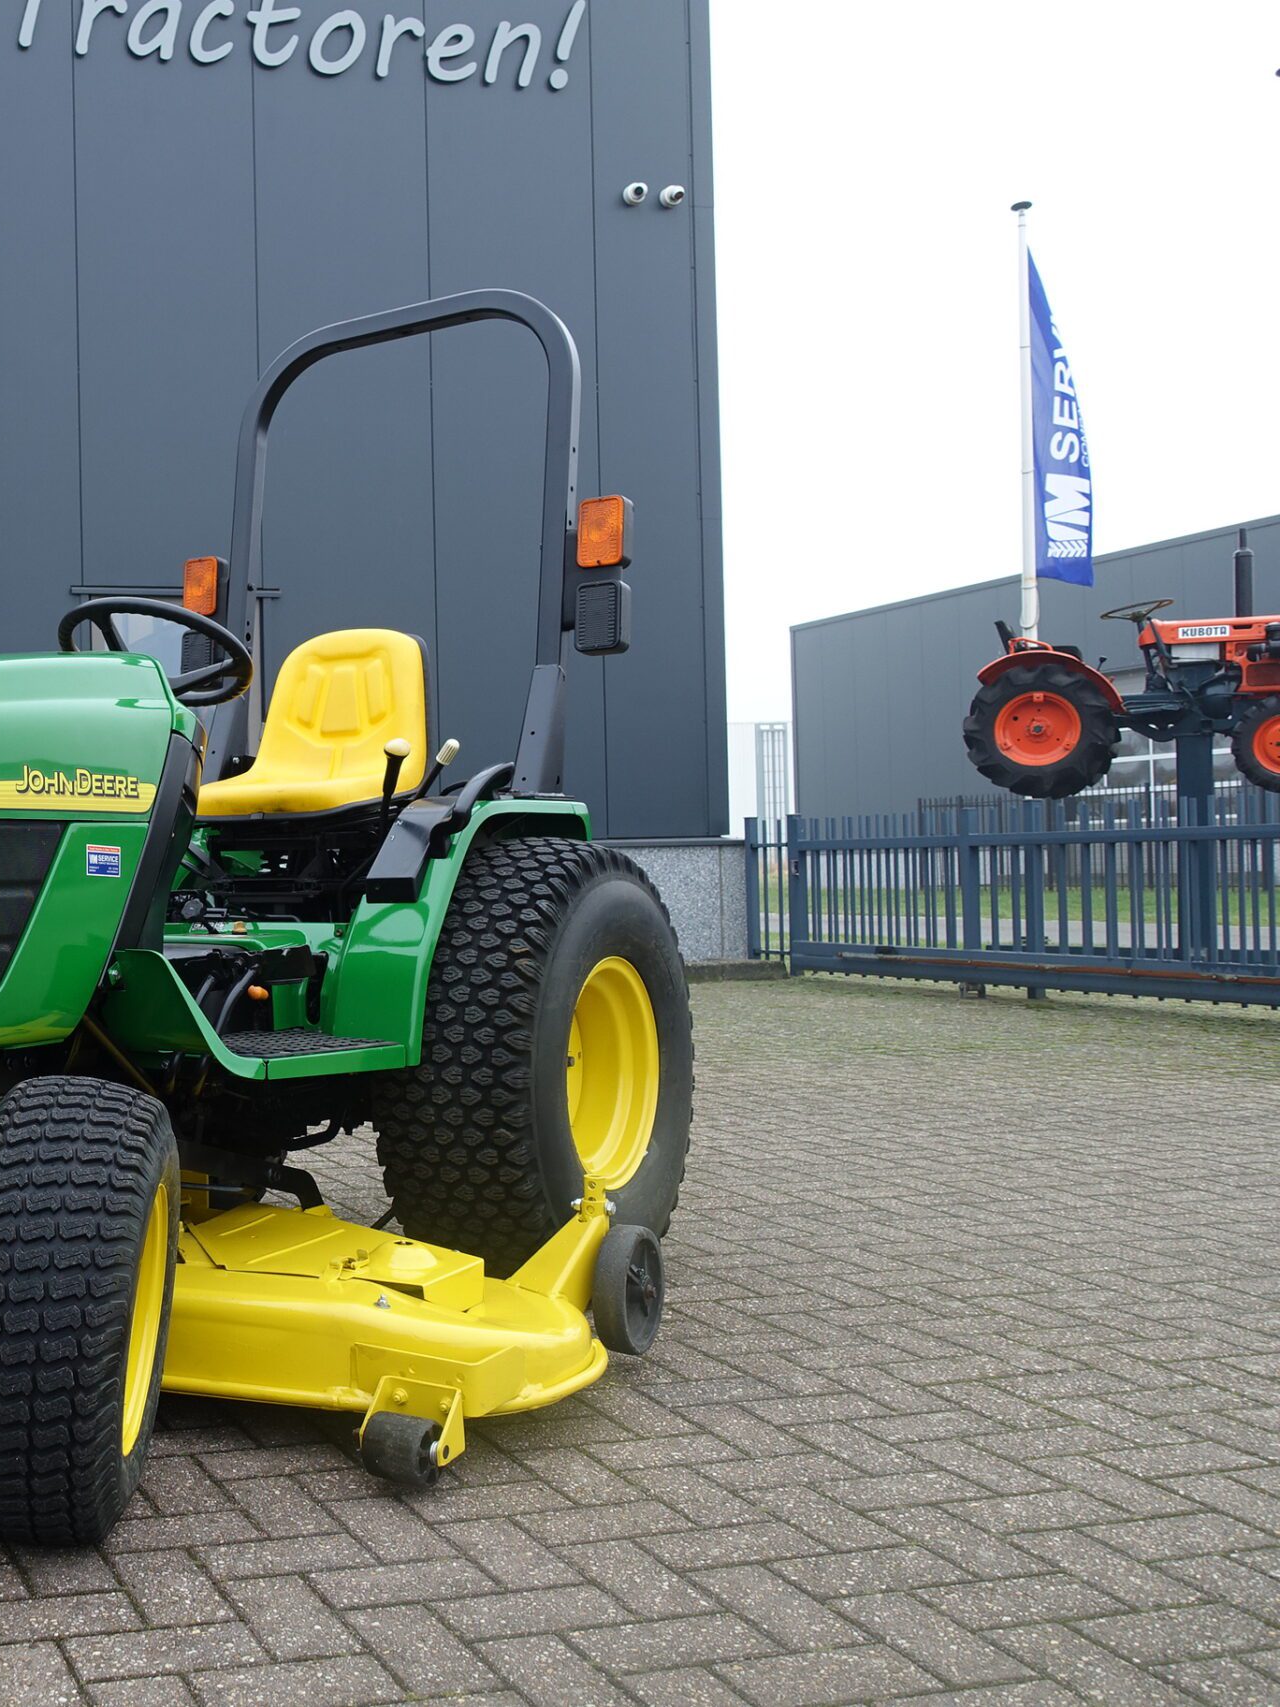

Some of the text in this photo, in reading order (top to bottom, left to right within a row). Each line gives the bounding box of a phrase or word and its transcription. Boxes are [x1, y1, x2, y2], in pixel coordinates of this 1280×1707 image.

[1181, 626, 1227, 637] KUBOTA
[16, 764, 139, 798] JOHN DEERE
